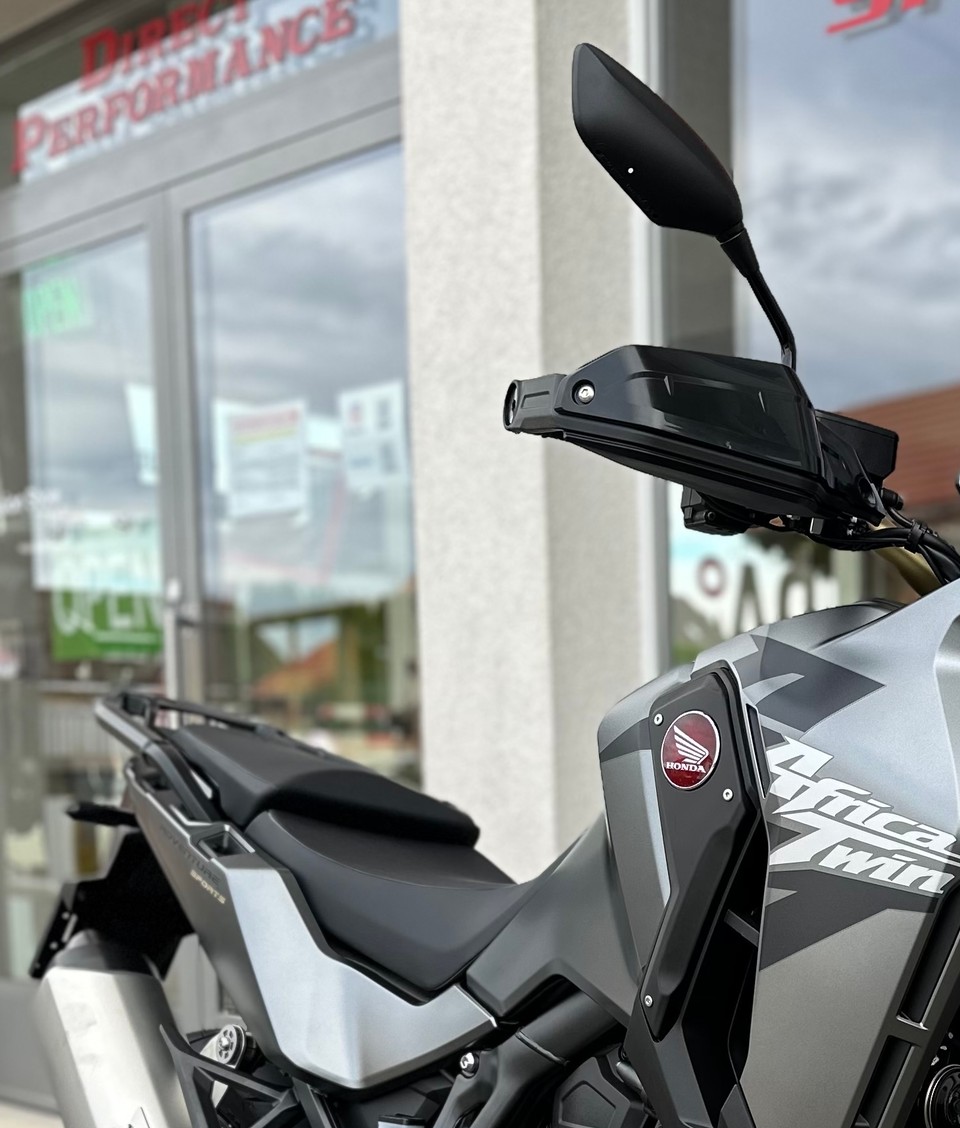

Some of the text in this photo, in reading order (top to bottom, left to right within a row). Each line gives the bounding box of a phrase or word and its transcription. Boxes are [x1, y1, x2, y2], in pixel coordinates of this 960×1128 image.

[12, 0, 357, 173] PERFORMANCE
[80, 0, 250, 92] DIRECT
[666, 761, 707, 774] HONDA
[765, 736, 957, 851] Africa
[190, 869, 226, 904] SPORTS
